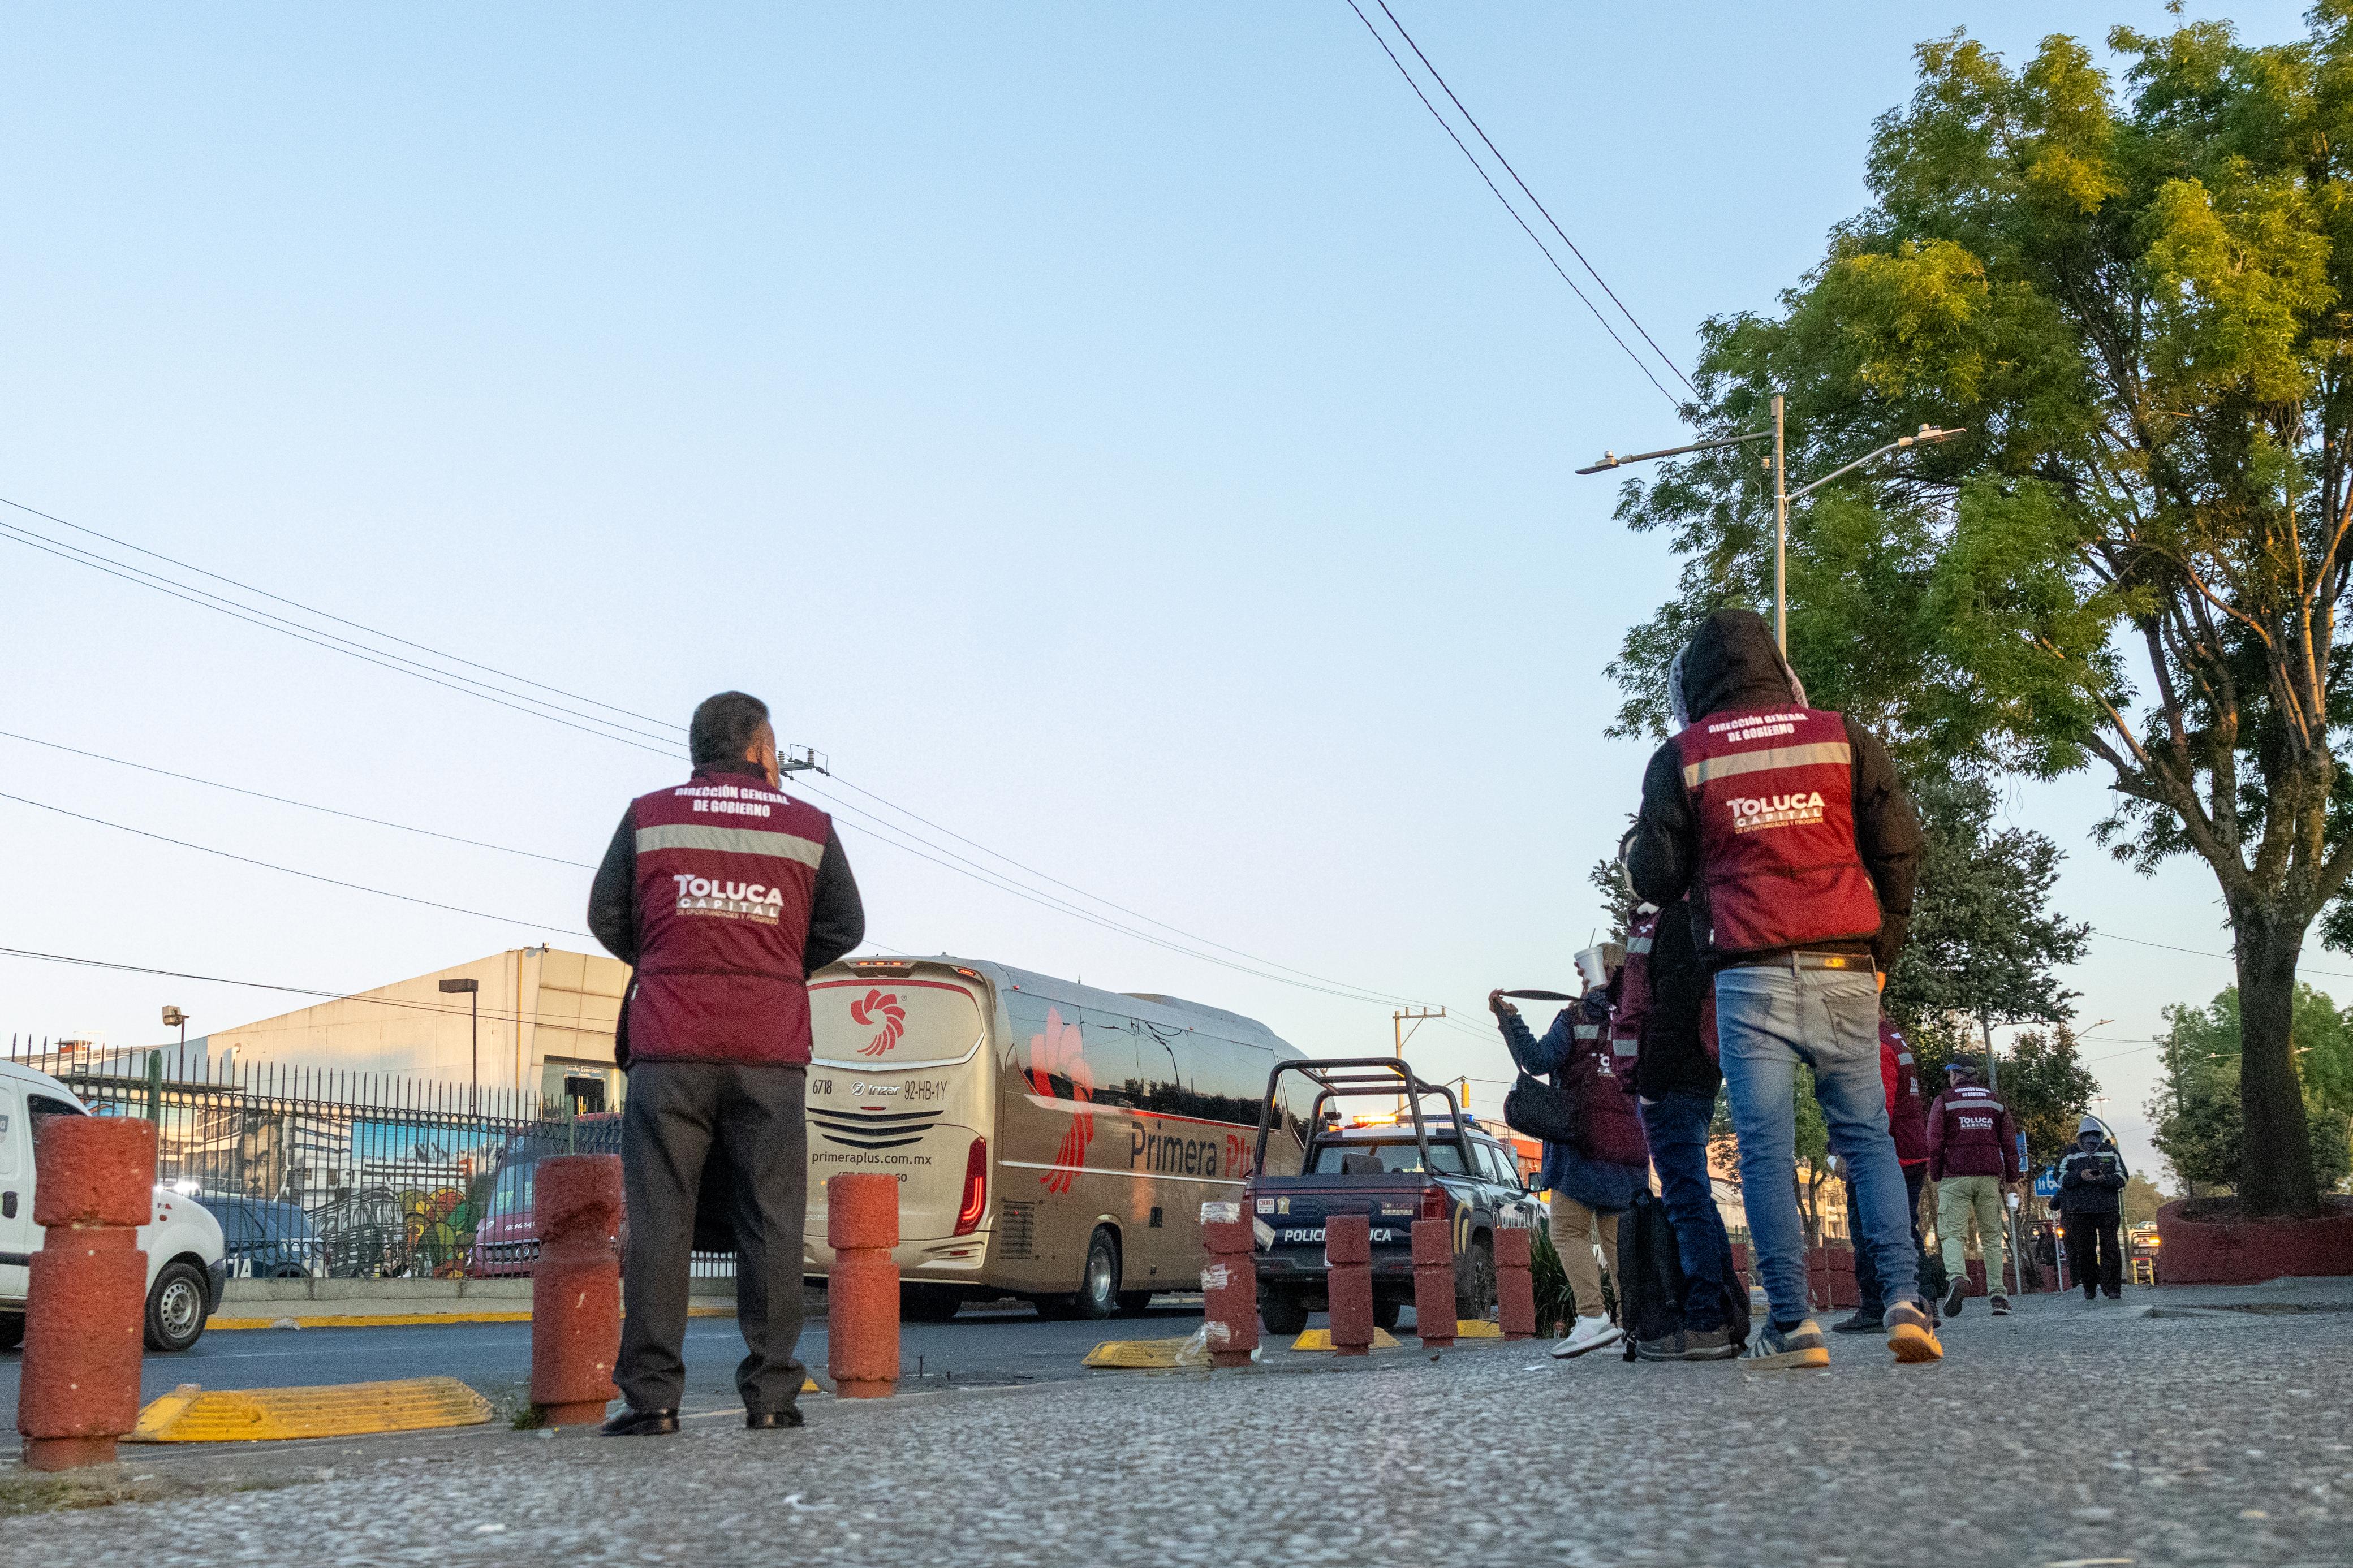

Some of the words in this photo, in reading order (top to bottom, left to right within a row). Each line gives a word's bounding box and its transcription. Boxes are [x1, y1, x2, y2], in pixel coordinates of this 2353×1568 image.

[1708, 715, 1764, 733] DIRECCIÓN
[1764, 713, 1808, 724] GENERAL
[1727, 731, 1742, 742] DE
[1742, 723, 1795, 740] GOBIERNO
[675, 784, 738, 799] DIRECCIÓN
[740, 788, 790, 805] GENERAL
[693, 800, 709, 811] DE
[710, 800, 770, 817] GOBIERNO
[1726, 792, 1825, 818] TOLUCA
[1736, 809, 1820, 827] CAPITAL
[674, 874, 784, 906] TOLUCA
[680, 898, 777, 917] CAPITAL
[813, 1079, 832, 1094] 6718
[905, 1081, 947, 1100] 92-HB-1Y
[812, 1152, 932, 1165] primeraplus.com.mx
[1130, 1121, 1217, 1176] Primera
[1225, 1134, 1266, 1178] Plu
[1285, 1228, 1326, 1242] POLICÍ
